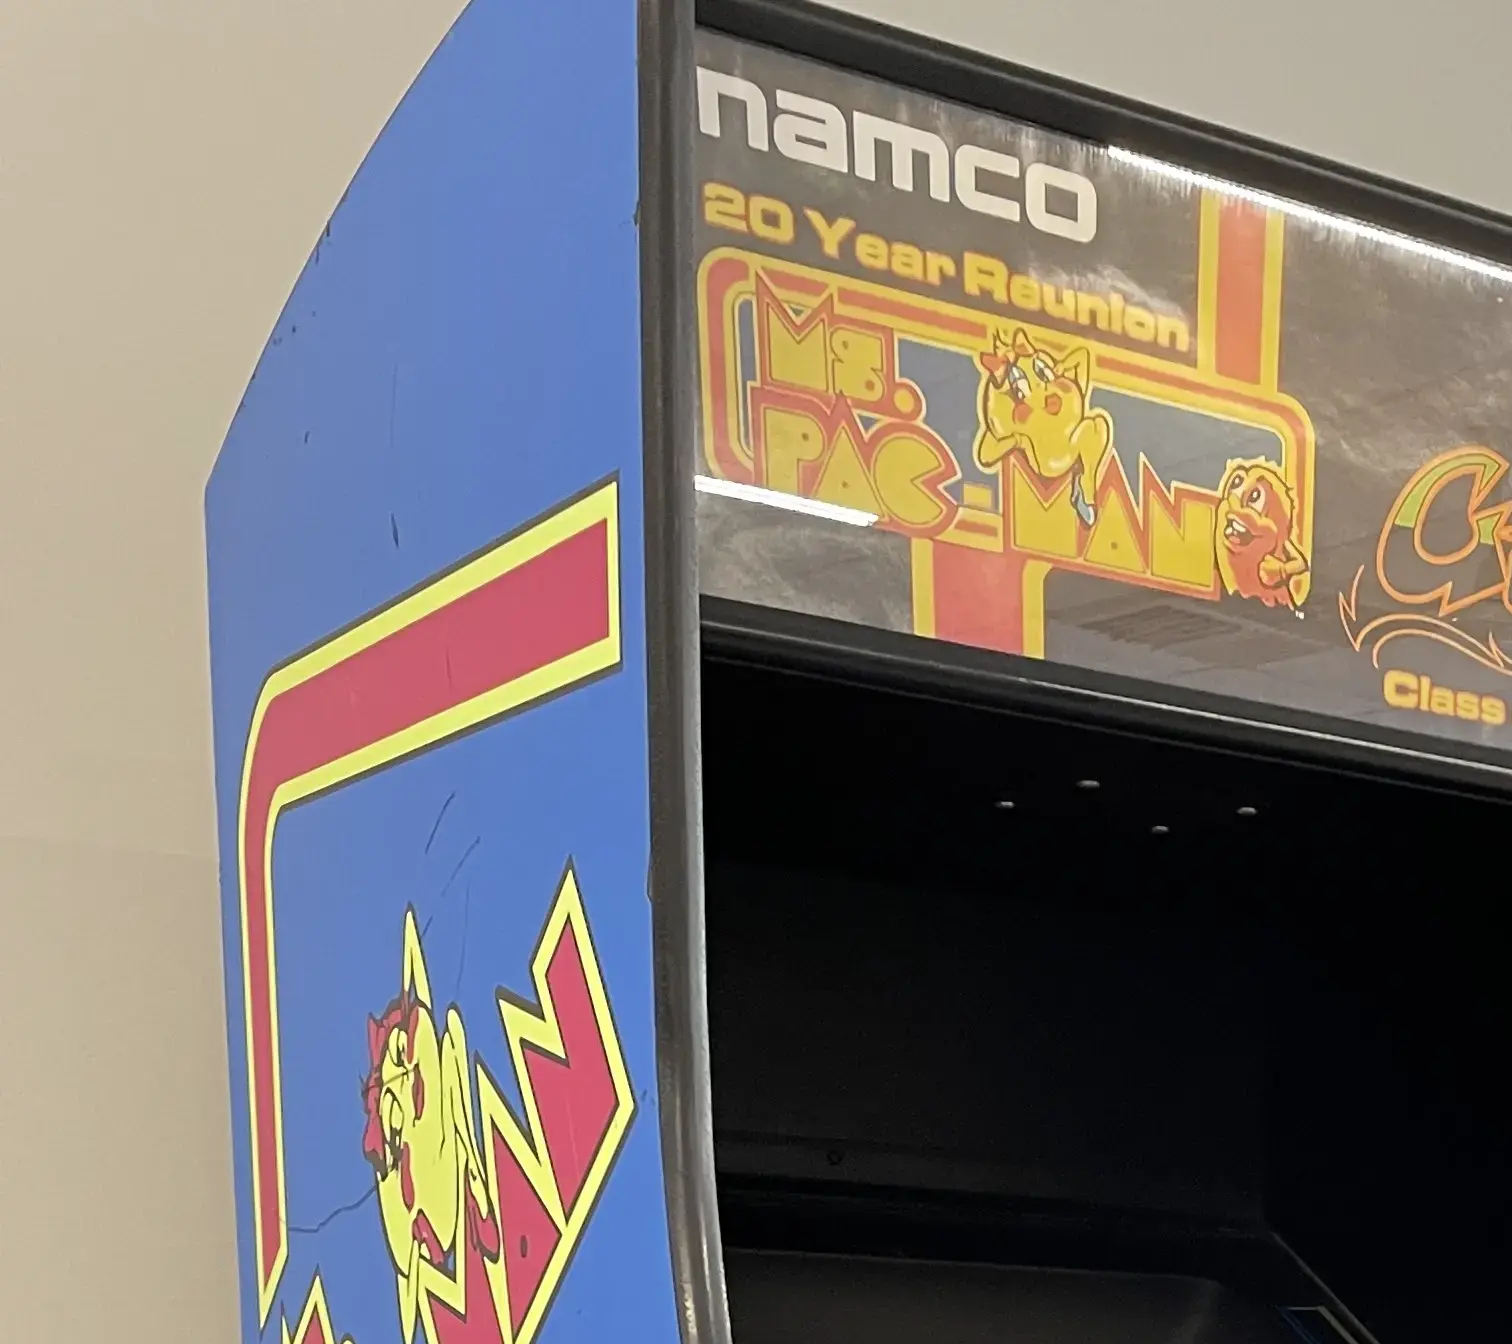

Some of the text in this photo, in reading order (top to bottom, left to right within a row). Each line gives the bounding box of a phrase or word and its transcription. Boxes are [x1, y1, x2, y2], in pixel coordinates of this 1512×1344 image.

[697, 66, 1098, 244] namco
[703, 181, 1193, 354] 20 Year Reunion
[1383, 669, 1506, 726] Class
